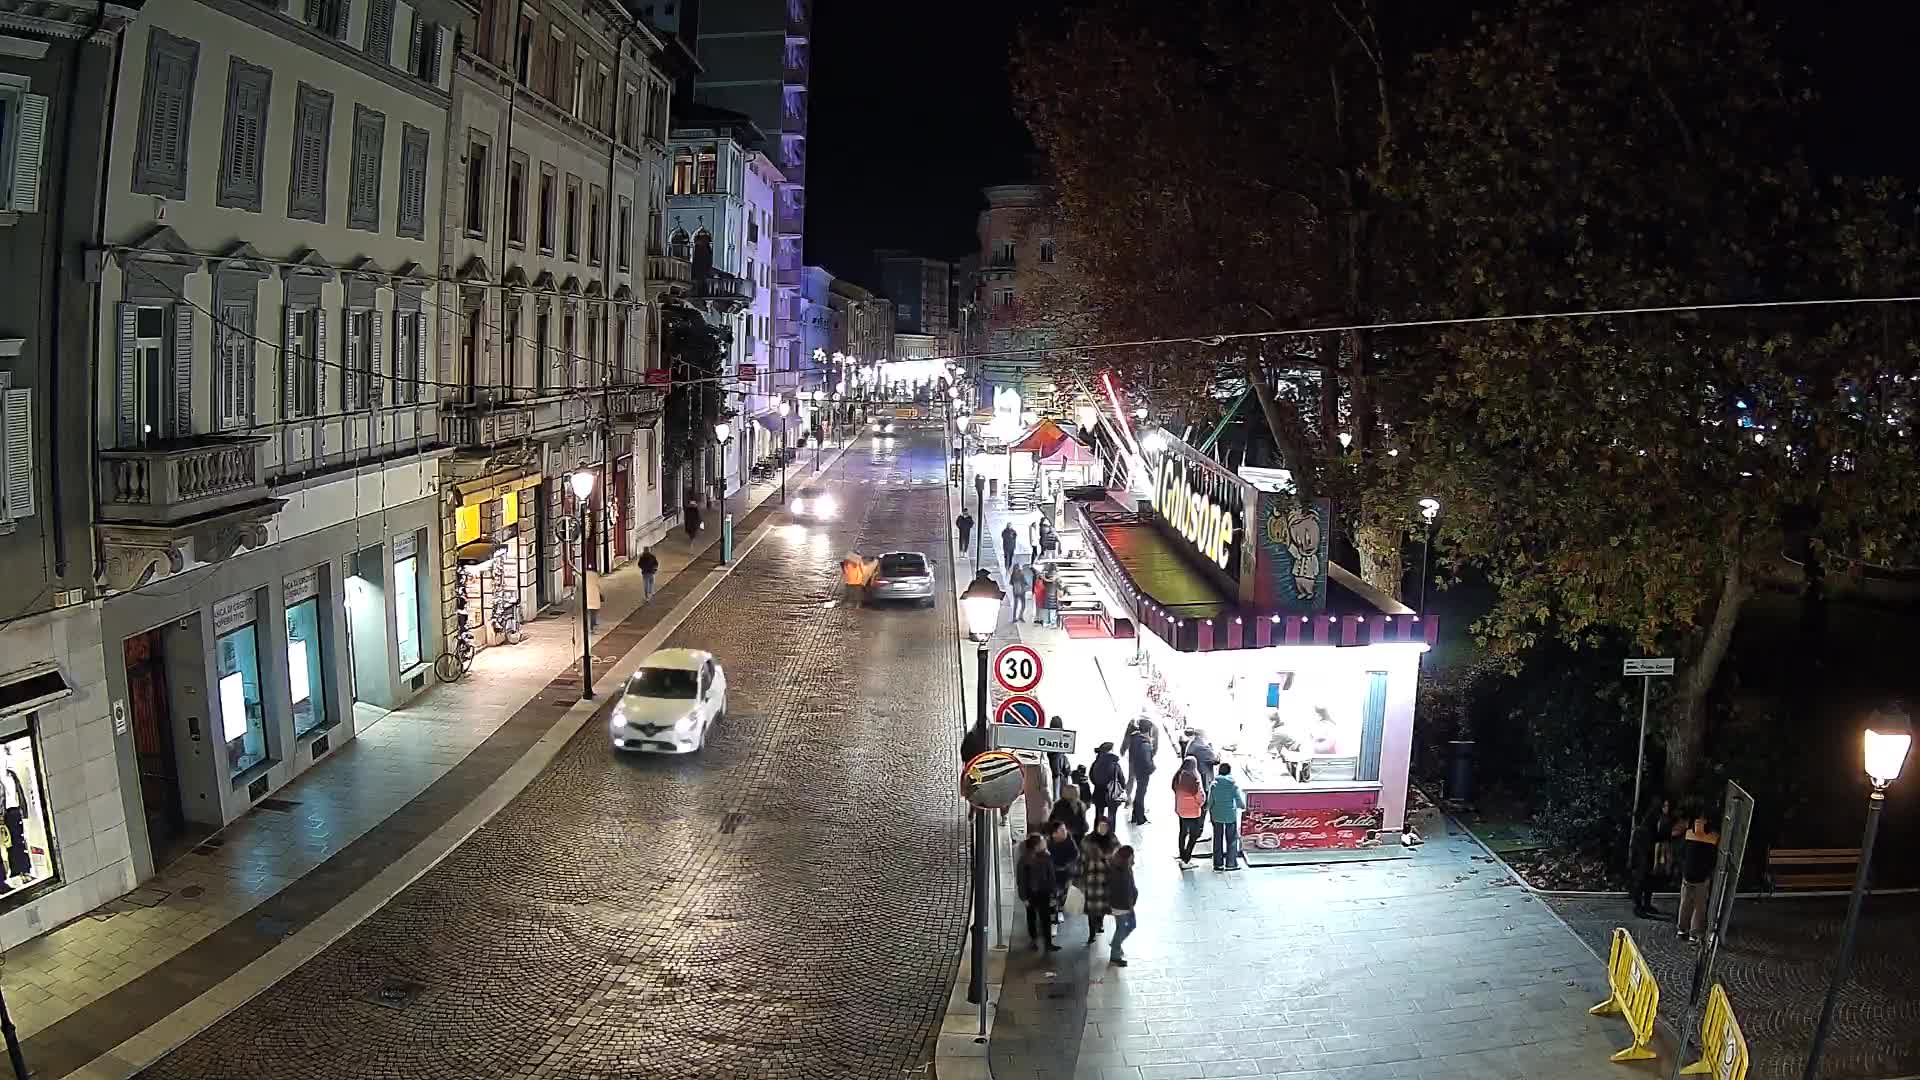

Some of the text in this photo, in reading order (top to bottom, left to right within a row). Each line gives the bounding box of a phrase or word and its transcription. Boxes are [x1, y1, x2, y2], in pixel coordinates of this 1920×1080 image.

[1162, 453, 1233, 569] Golosone
[1005, 658, 1033, 679] 30
[1037, 737, 1070, 749] Dante
